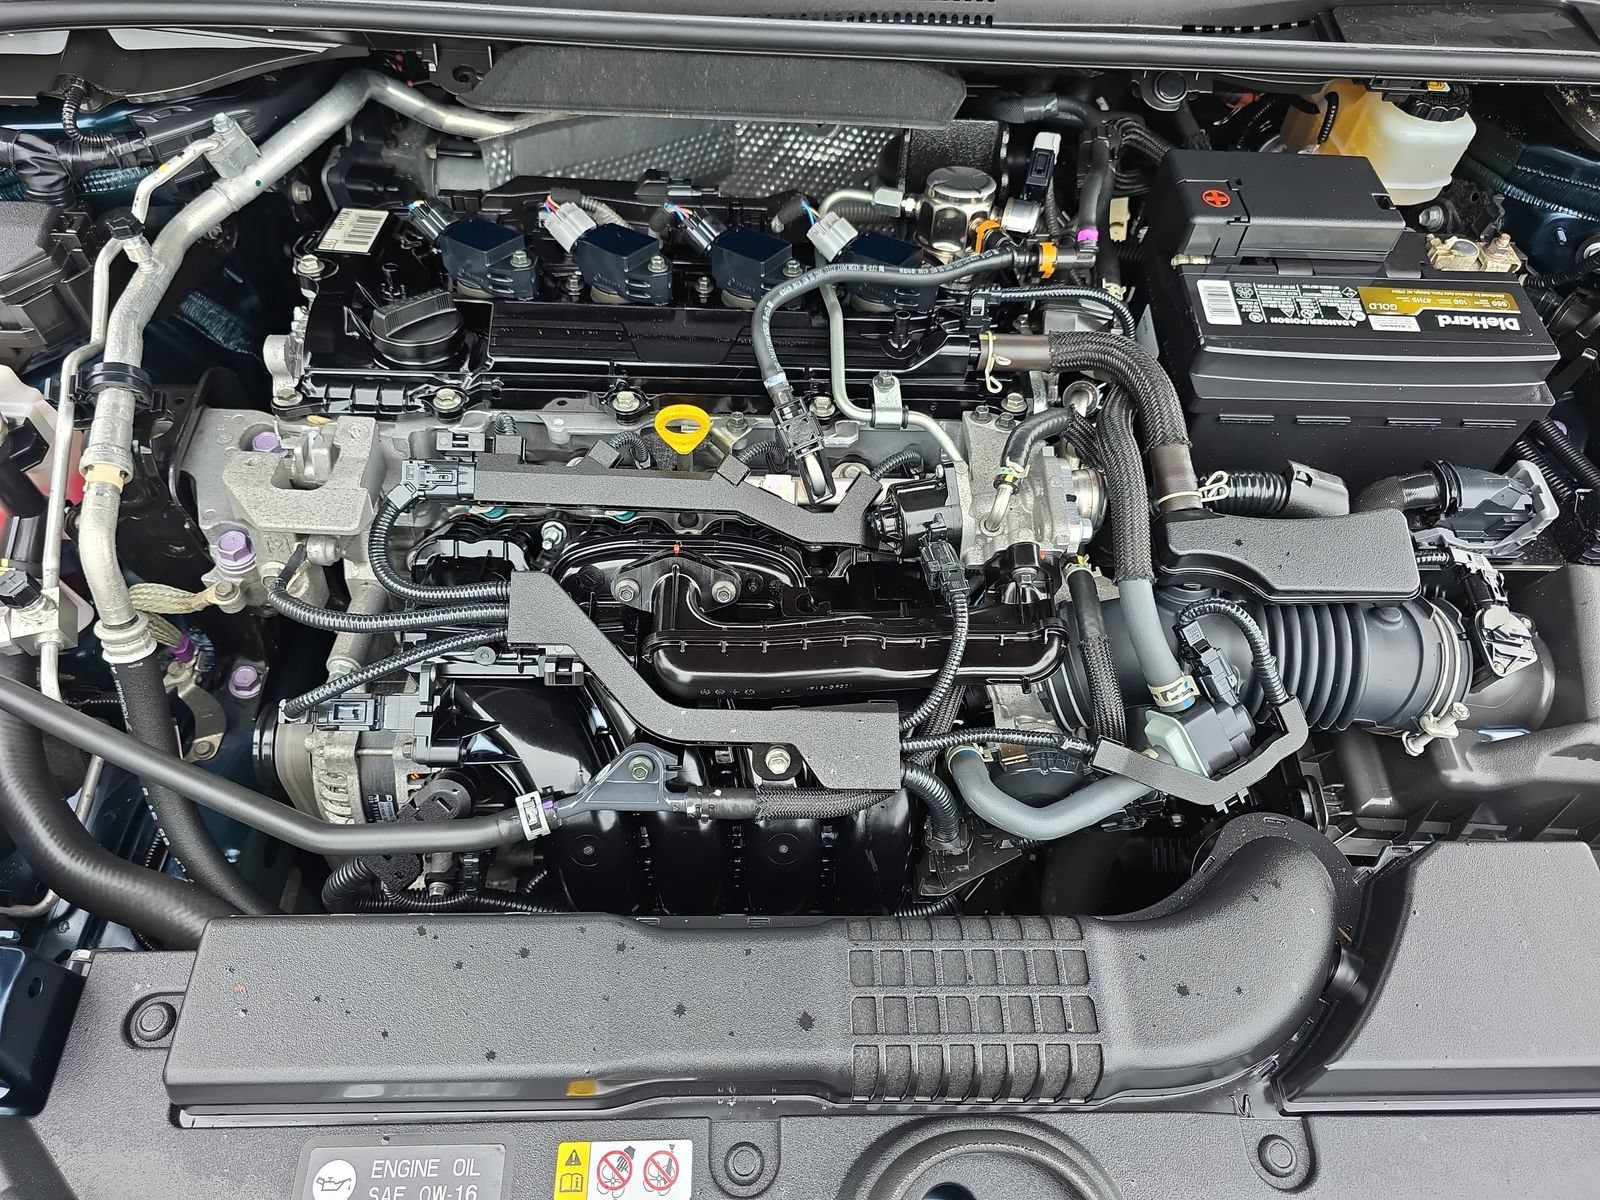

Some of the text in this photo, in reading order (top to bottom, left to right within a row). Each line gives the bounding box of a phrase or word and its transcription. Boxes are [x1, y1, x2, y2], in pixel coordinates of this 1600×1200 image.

[1368, 302, 1398, 311] GOLD
[1437, 315, 1521, 331] DieHard
[371, 1157, 481, 1178] ENGINE OIL
[419, 1184, 478, 1200] 0W-16
